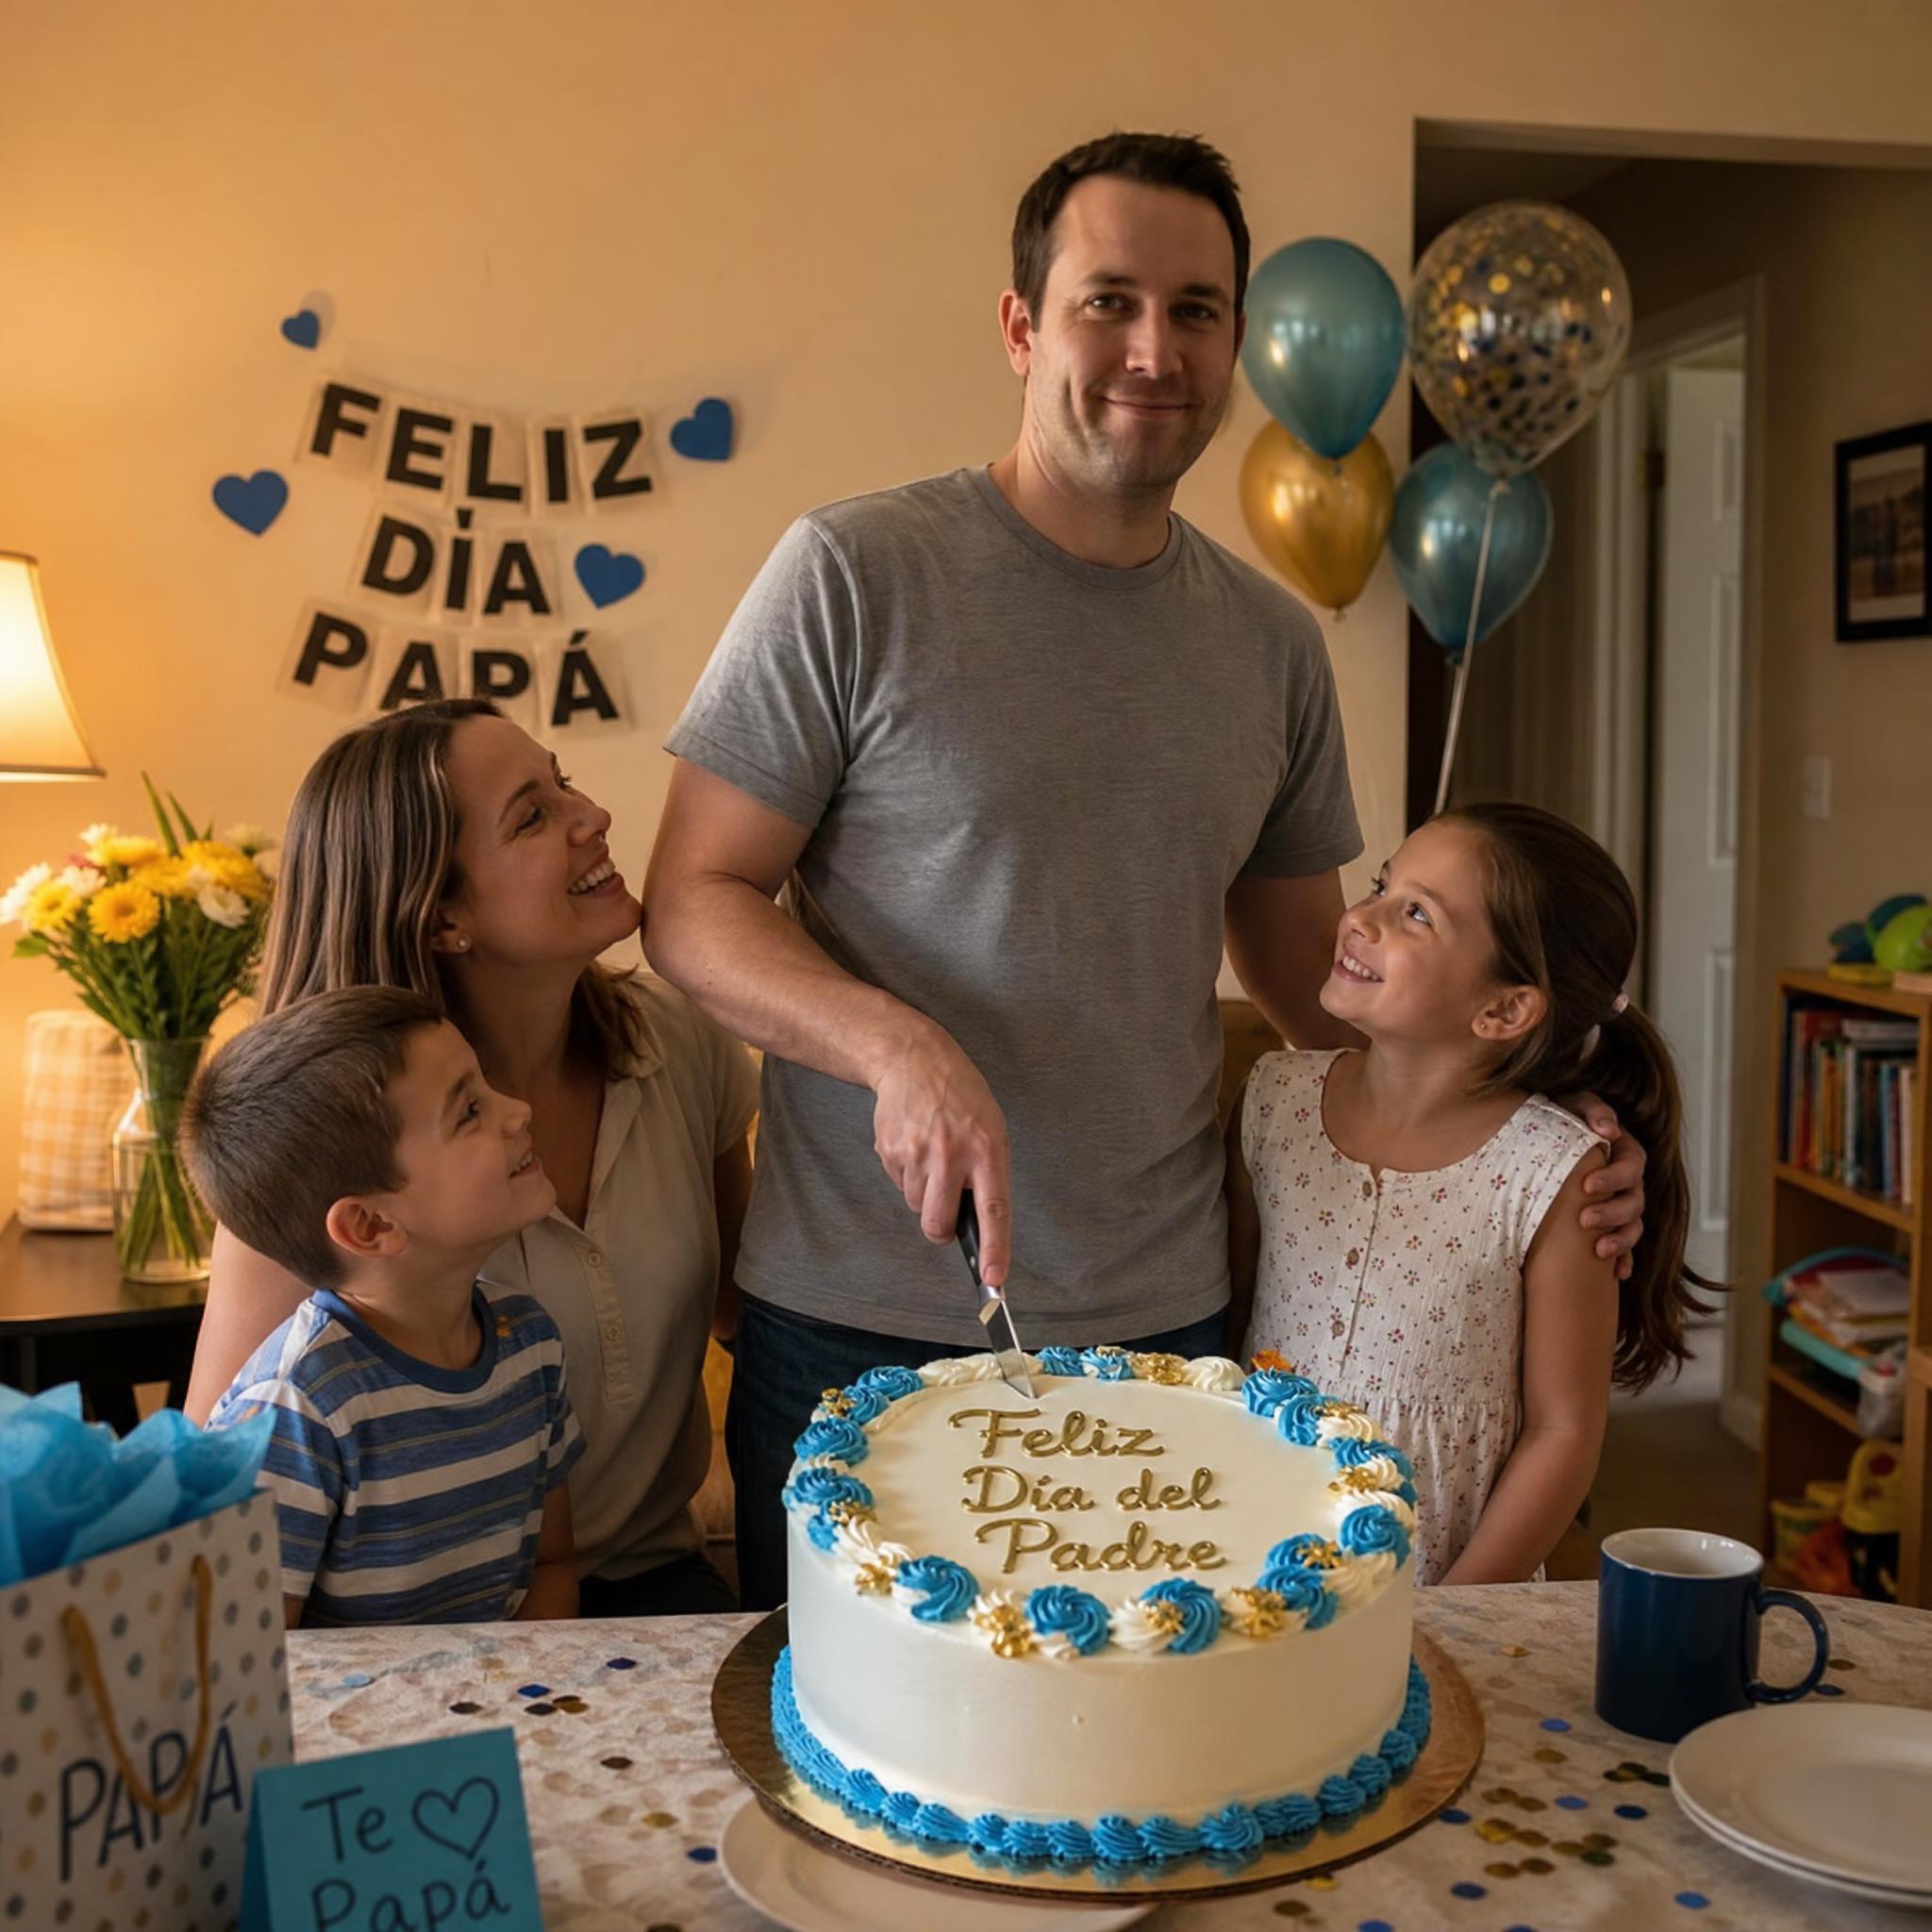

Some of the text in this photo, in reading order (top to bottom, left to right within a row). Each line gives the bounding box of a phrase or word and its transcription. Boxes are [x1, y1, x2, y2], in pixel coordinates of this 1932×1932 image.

[310, 381, 653, 504] FELIZ
[361, 508, 552, 616] DÍA
[292, 611, 620, 727] PAPÁ
[947, 1407, 1165, 1458] Feliz
[961, 1464, 1222, 1513] Día del
[974, 1517, 1226, 1574] Padre
[59, 1701, 243, 1882] PAPÁ
[301, 1785, 394, 1862] Te
[310, 1858, 512, 1932] Papá
